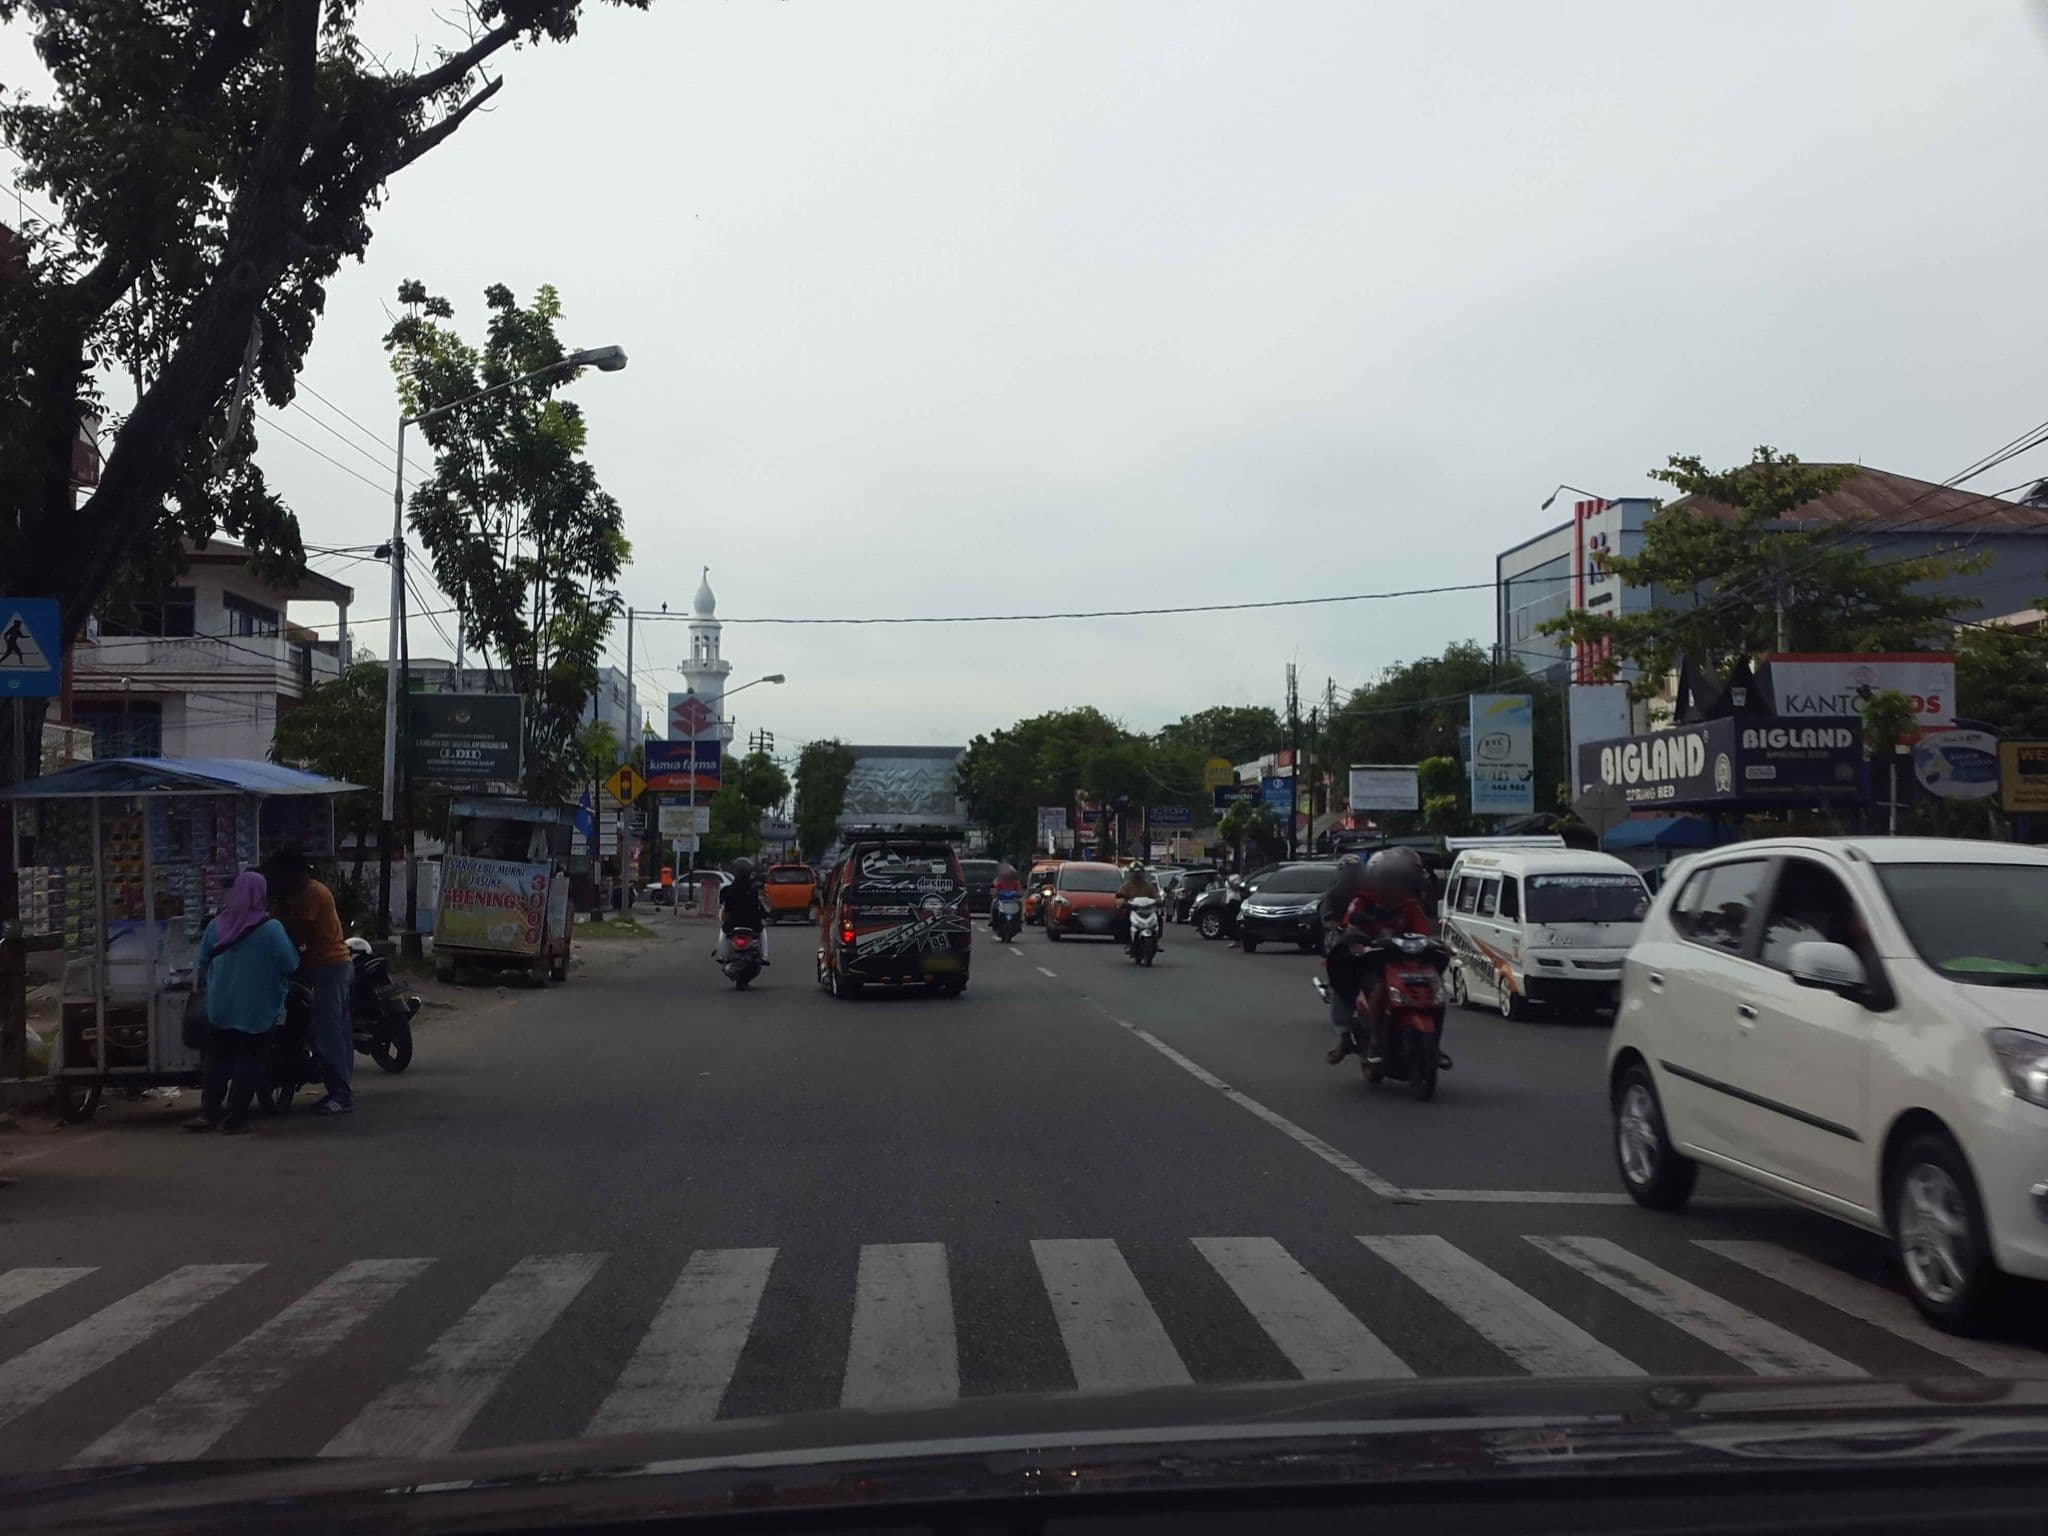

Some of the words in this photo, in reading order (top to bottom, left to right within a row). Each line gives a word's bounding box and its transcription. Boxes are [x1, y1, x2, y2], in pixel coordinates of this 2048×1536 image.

[1786, 694, 1864, 714] KANTO
[1909, 694, 1942, 714] OS
[1742, 728, 1853, 749] BIGLAND
[649, 760, 681, 770] kimia
[1600, 733, 1705, 785] BIGLAND
[1224, 792, 1253, 801] mandiri
[1625, 785, 1657, 802] SPRING
[1657, 784, 1675, 800] BED
[469, 876, 503, 888] JASUKE
[916, 873, 954, 893] design
